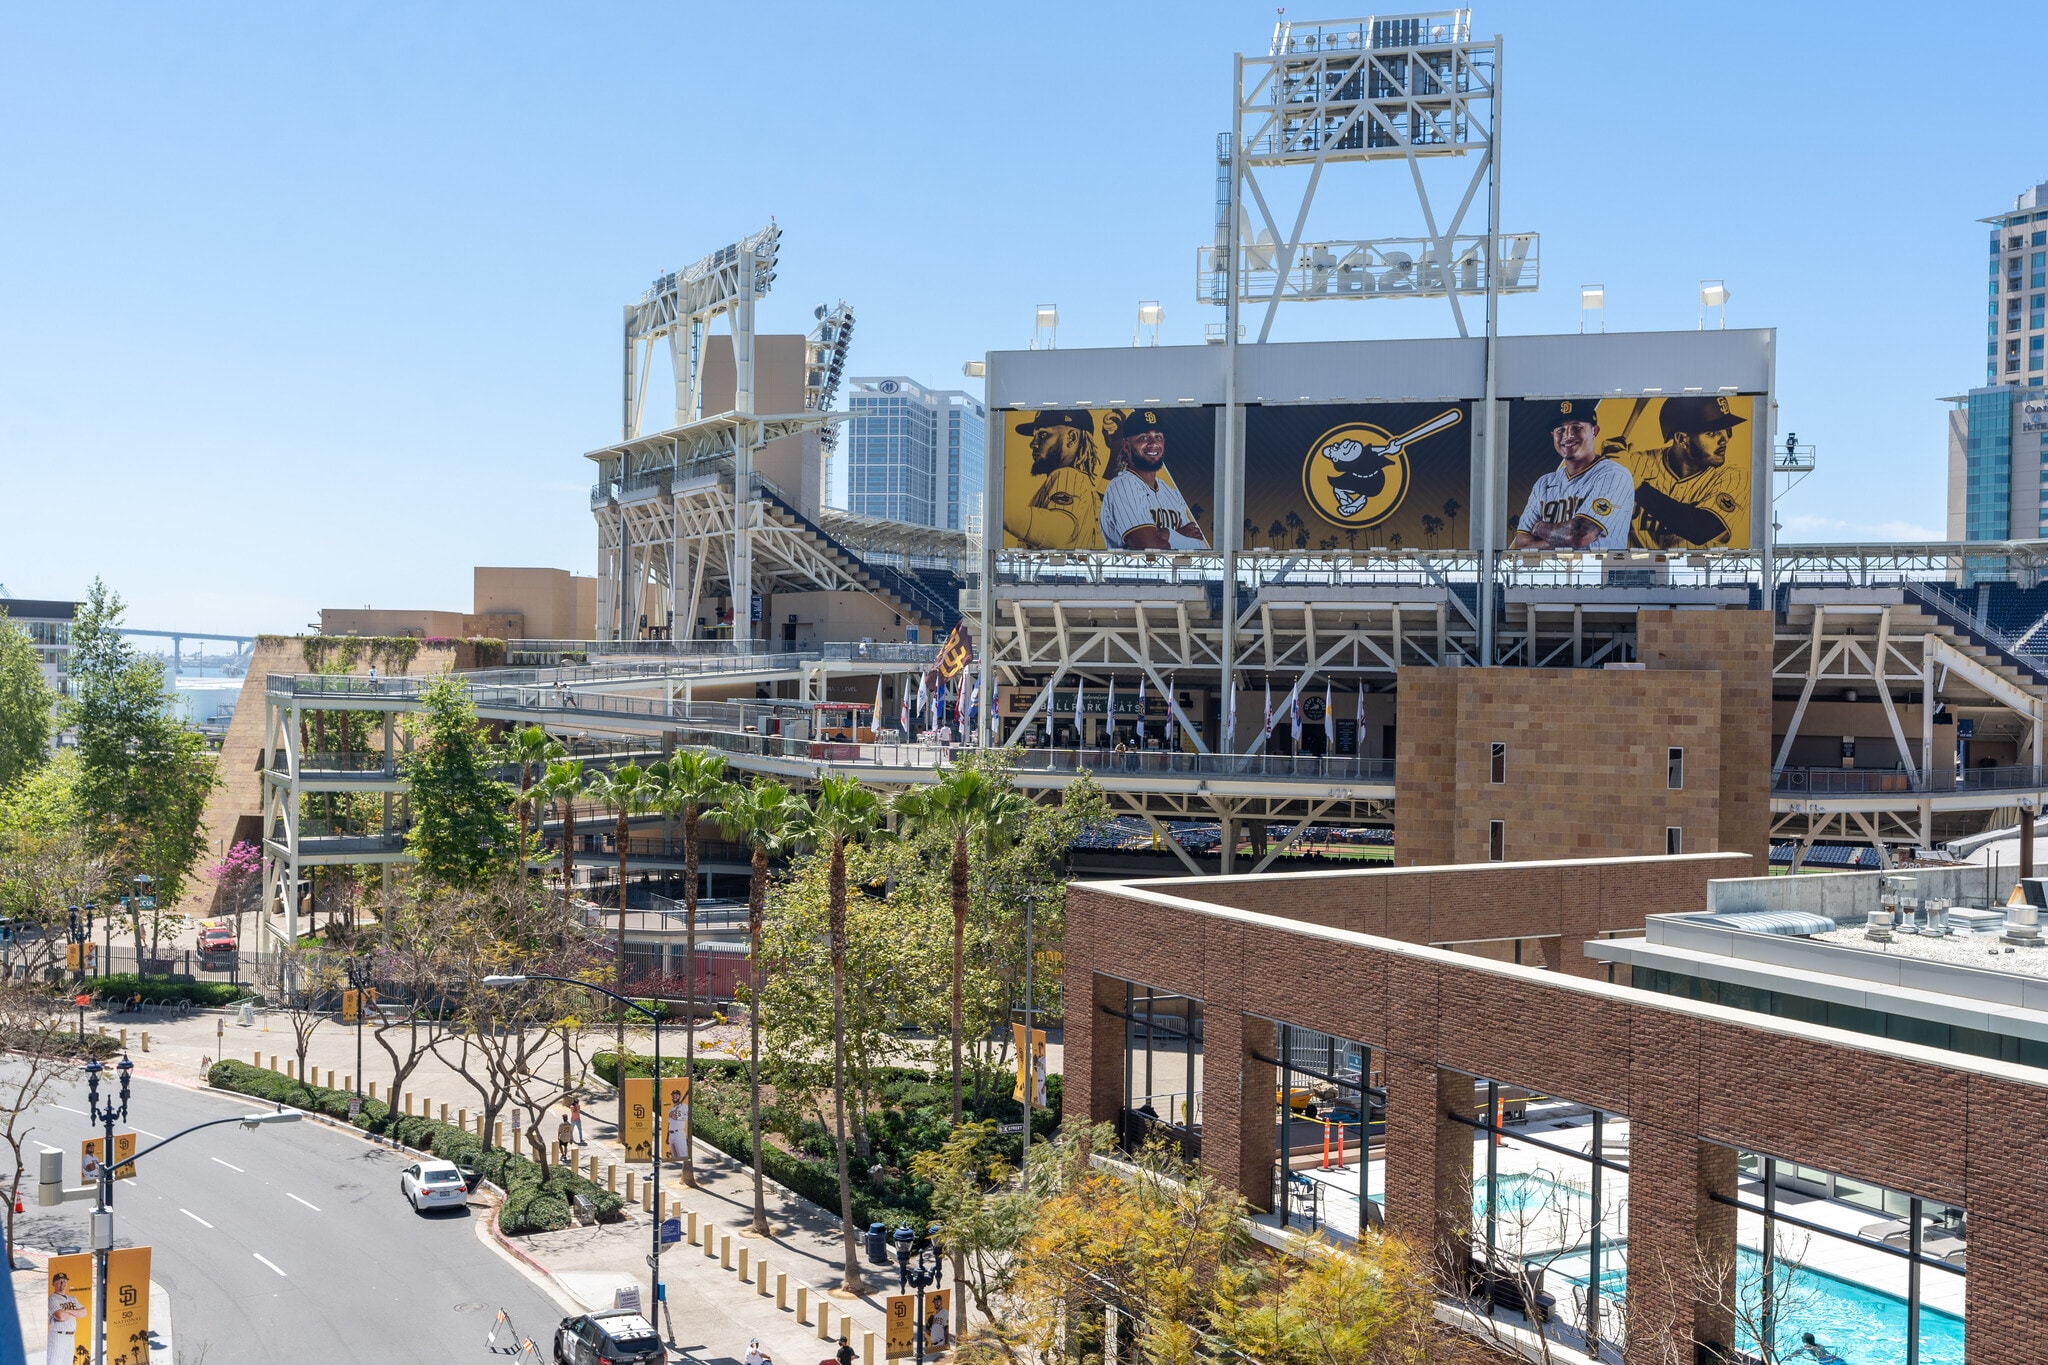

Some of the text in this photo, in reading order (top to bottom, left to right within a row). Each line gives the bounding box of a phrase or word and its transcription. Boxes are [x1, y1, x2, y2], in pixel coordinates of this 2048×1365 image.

[119, 1284, 137, 1307] SD
[894, 1301, 907, 1318] SD
[113, 1316, 142, 1325] NATIONAL
